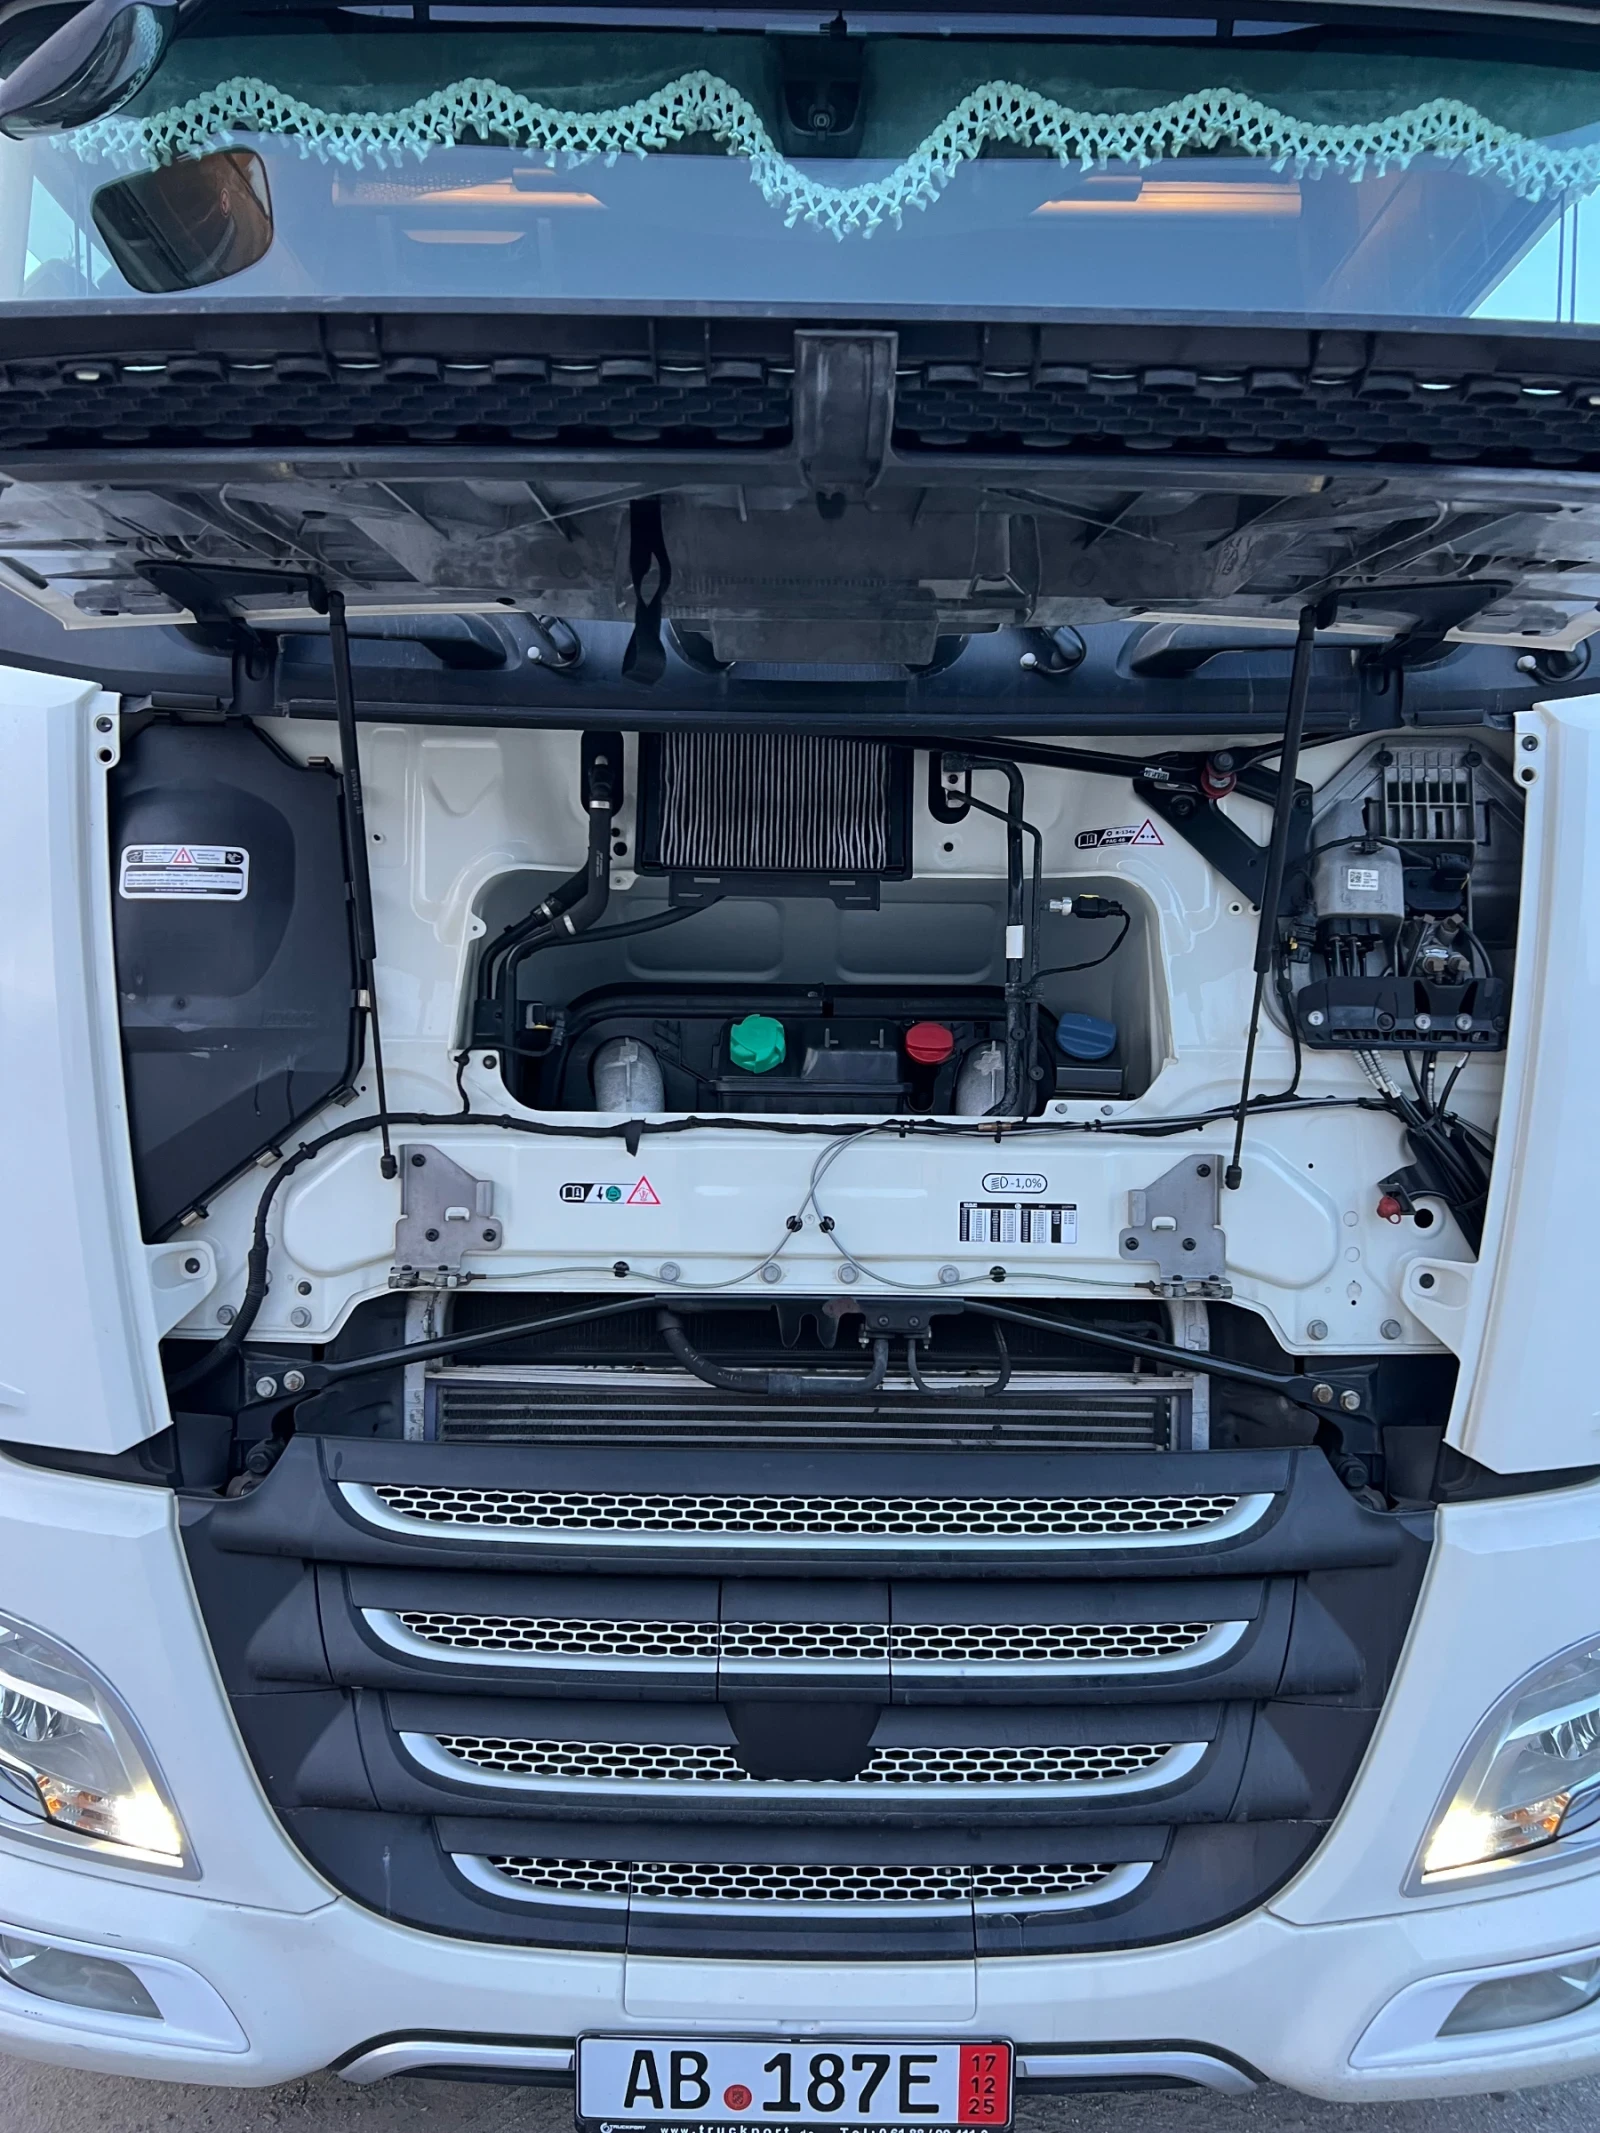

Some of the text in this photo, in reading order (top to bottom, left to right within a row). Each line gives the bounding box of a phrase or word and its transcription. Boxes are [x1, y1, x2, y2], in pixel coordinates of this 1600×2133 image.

[972, 2053, 996, 2072] 17
[623, 2049, 940, 2114] AB 187E
[971, 2075, 996, 2094] 12
[968, 2097, 995, 2115] 25
